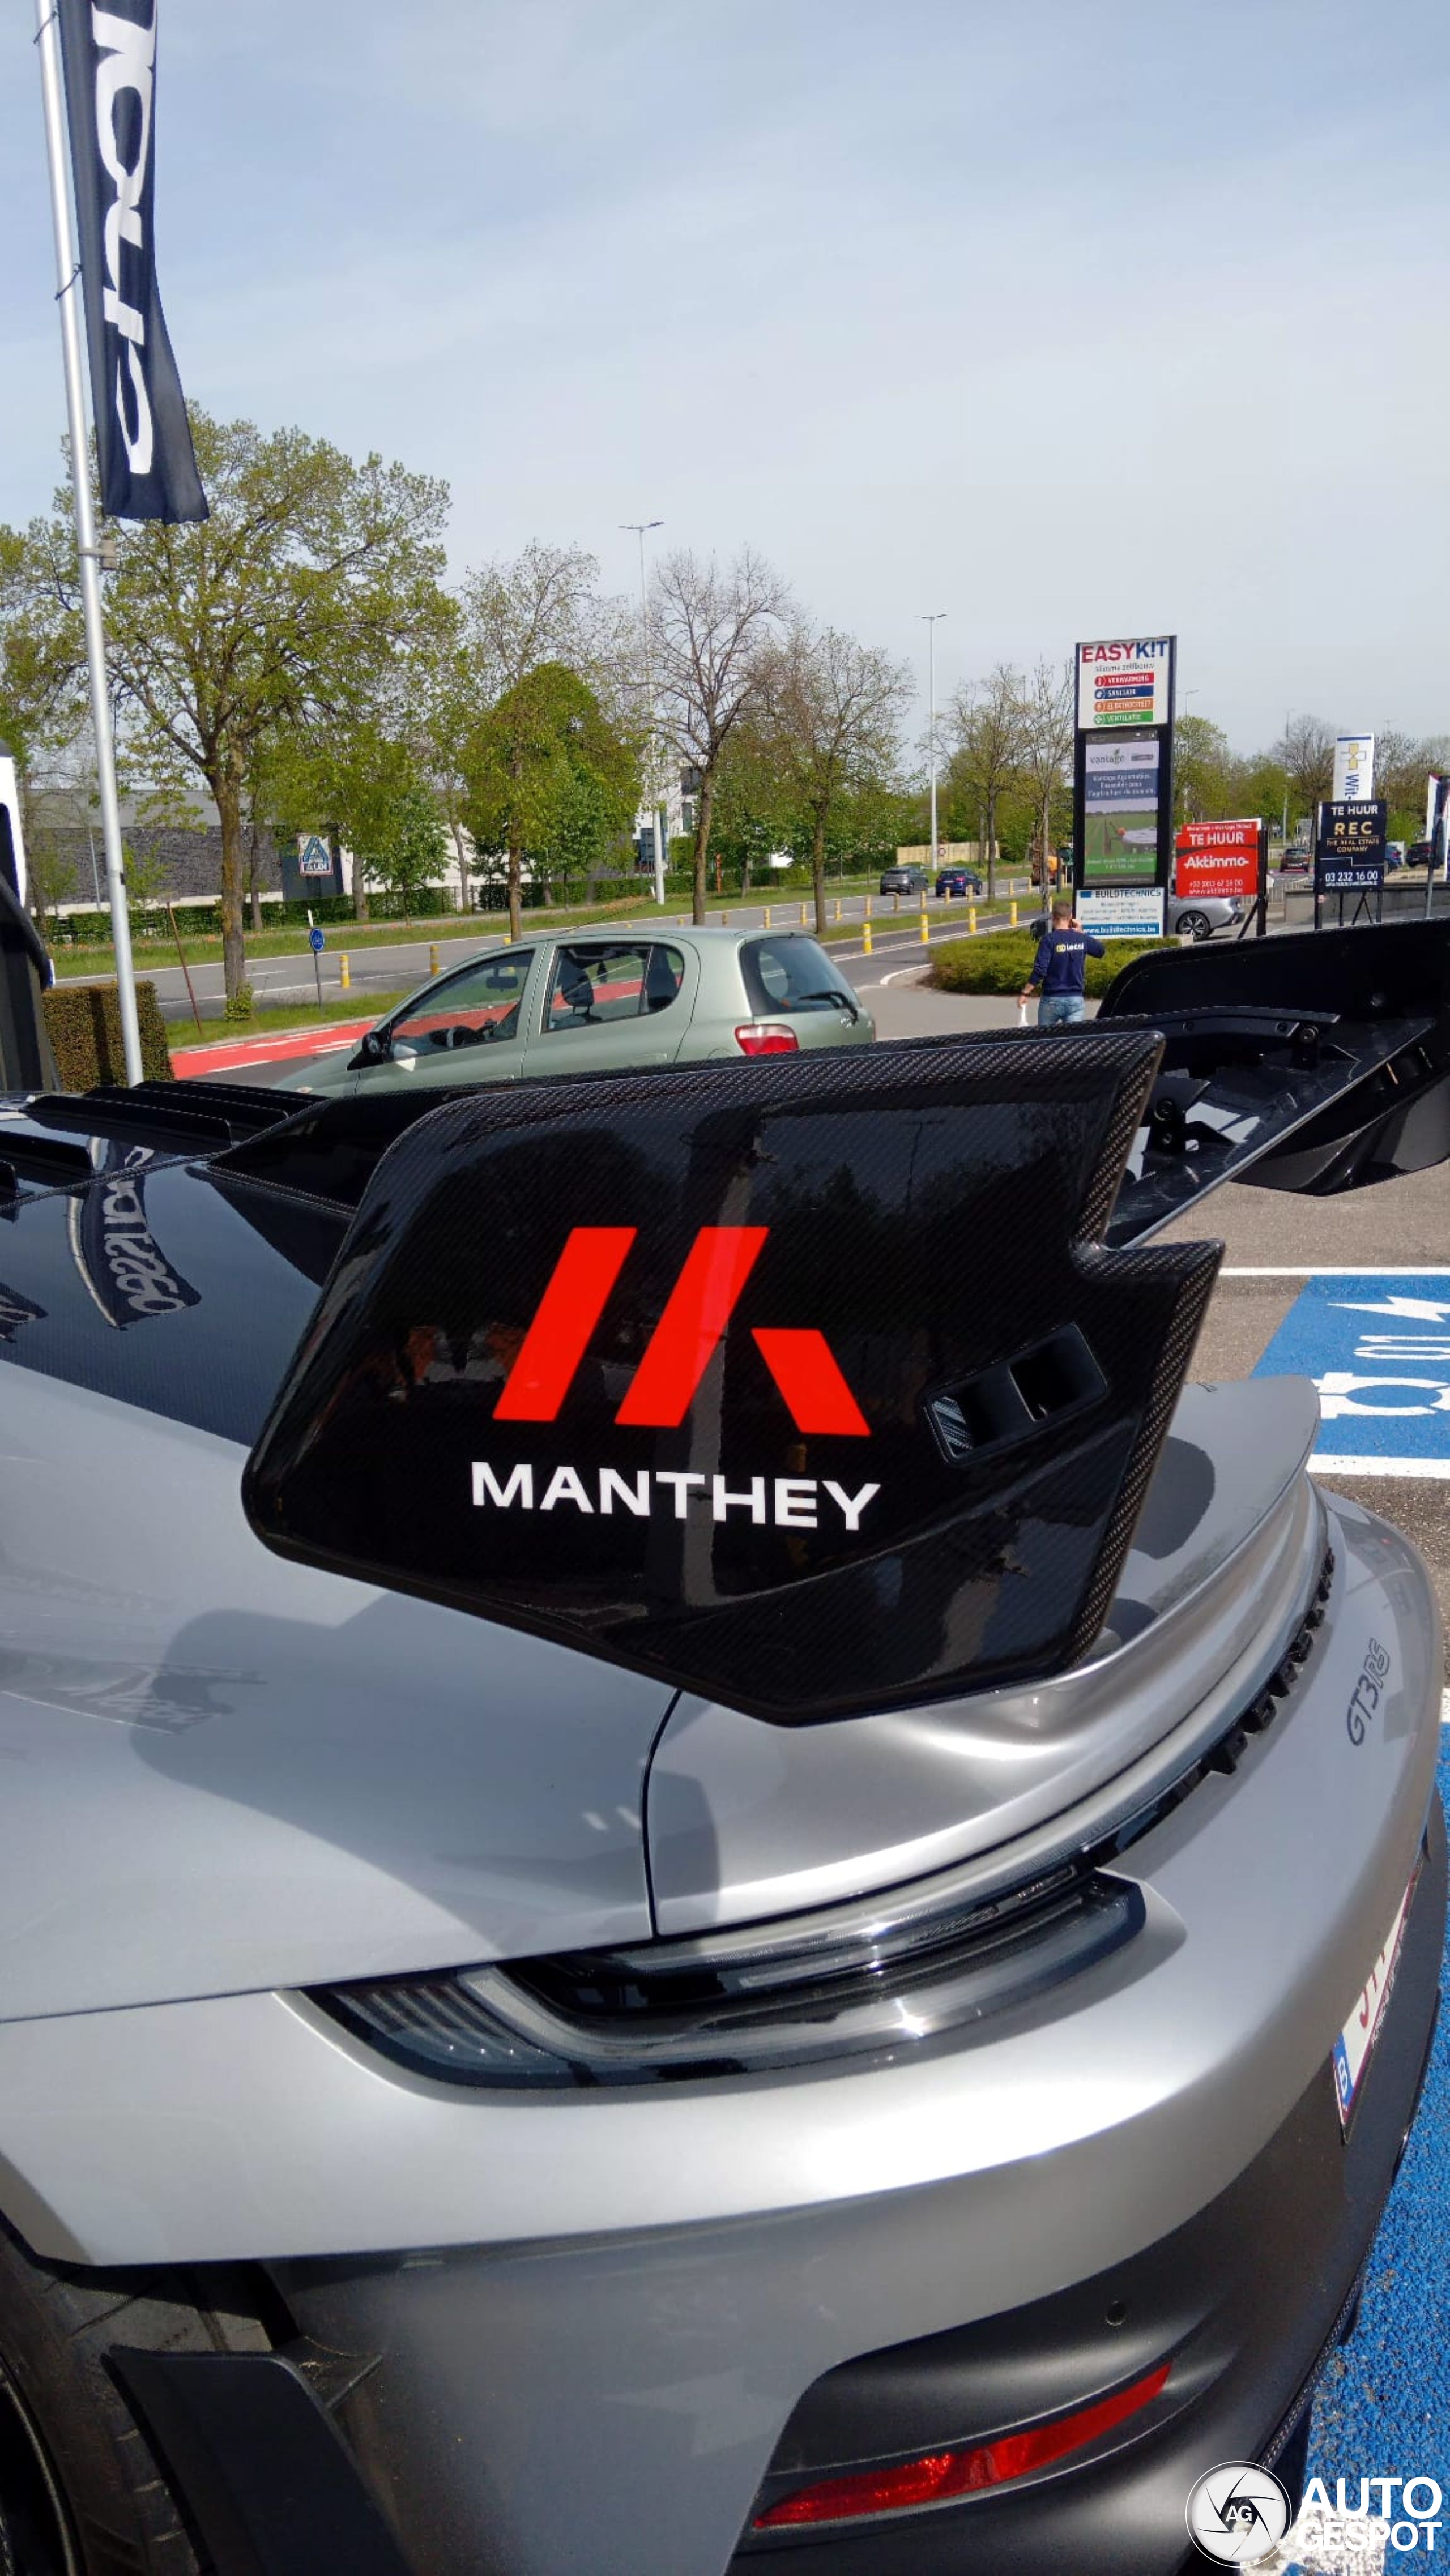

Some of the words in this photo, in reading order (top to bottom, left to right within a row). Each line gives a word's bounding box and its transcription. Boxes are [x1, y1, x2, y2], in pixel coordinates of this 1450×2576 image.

[1331, 806, 1344, 816] TE
[1347, 805, 1378, 815] HUUR
[1334, 821, 1373, 836] REC
[1189, 834, 1204, 846] TE
[1207, 831, 1244, 845] HUUR
[1325, 872, 1335, 882] 03
[1338, 871, 1353, 882] 232
[1356, 870, 1365, 881] 16
[1367, 870, 1378, 881] 00
[1095, 889, 1161, 898] BUILDTECHNICS
[471, 1461, 881, 1531] MANTHEY
